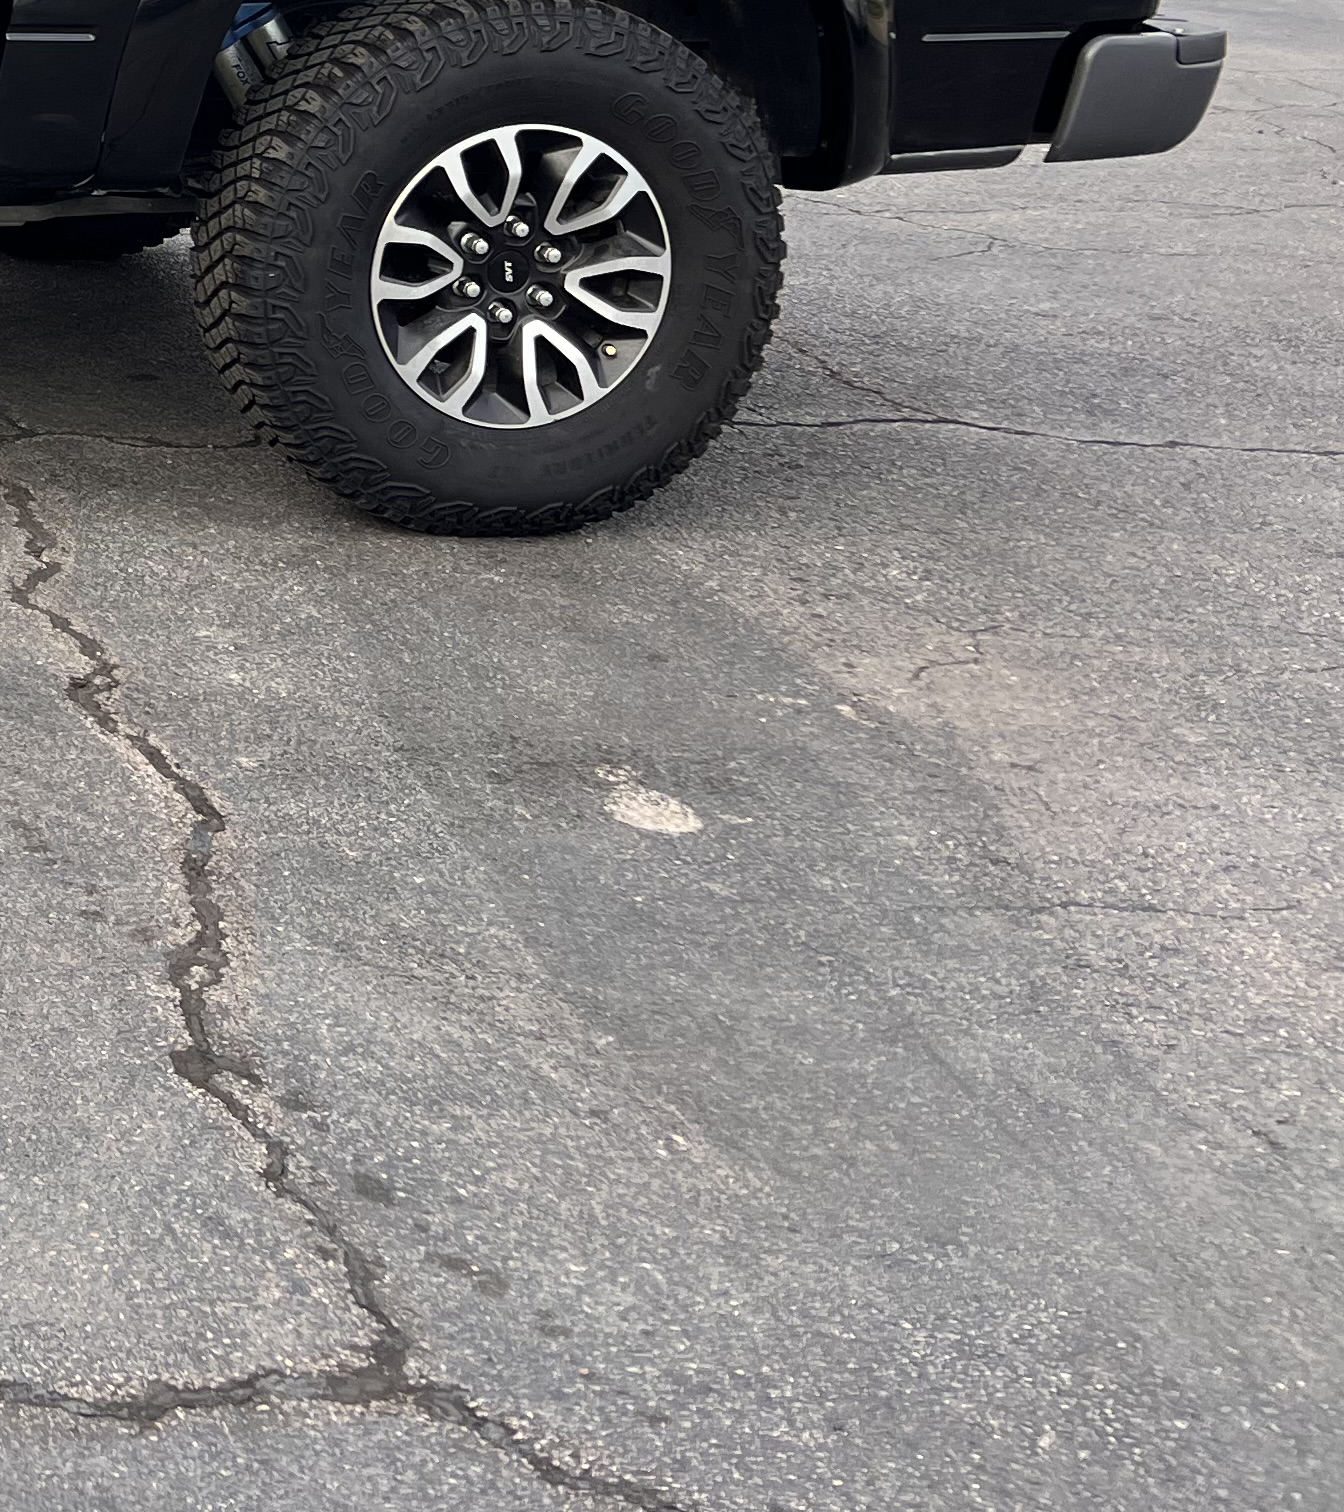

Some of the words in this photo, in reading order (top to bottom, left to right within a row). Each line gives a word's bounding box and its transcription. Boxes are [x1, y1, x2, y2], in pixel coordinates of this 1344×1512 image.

[231, 63, 251, 86] FOX
[319, 169, 453, 472] GOODYEAR
[503, 260, 514, 283] SVT
[611, 92, 745, 393] GOODYEAR
